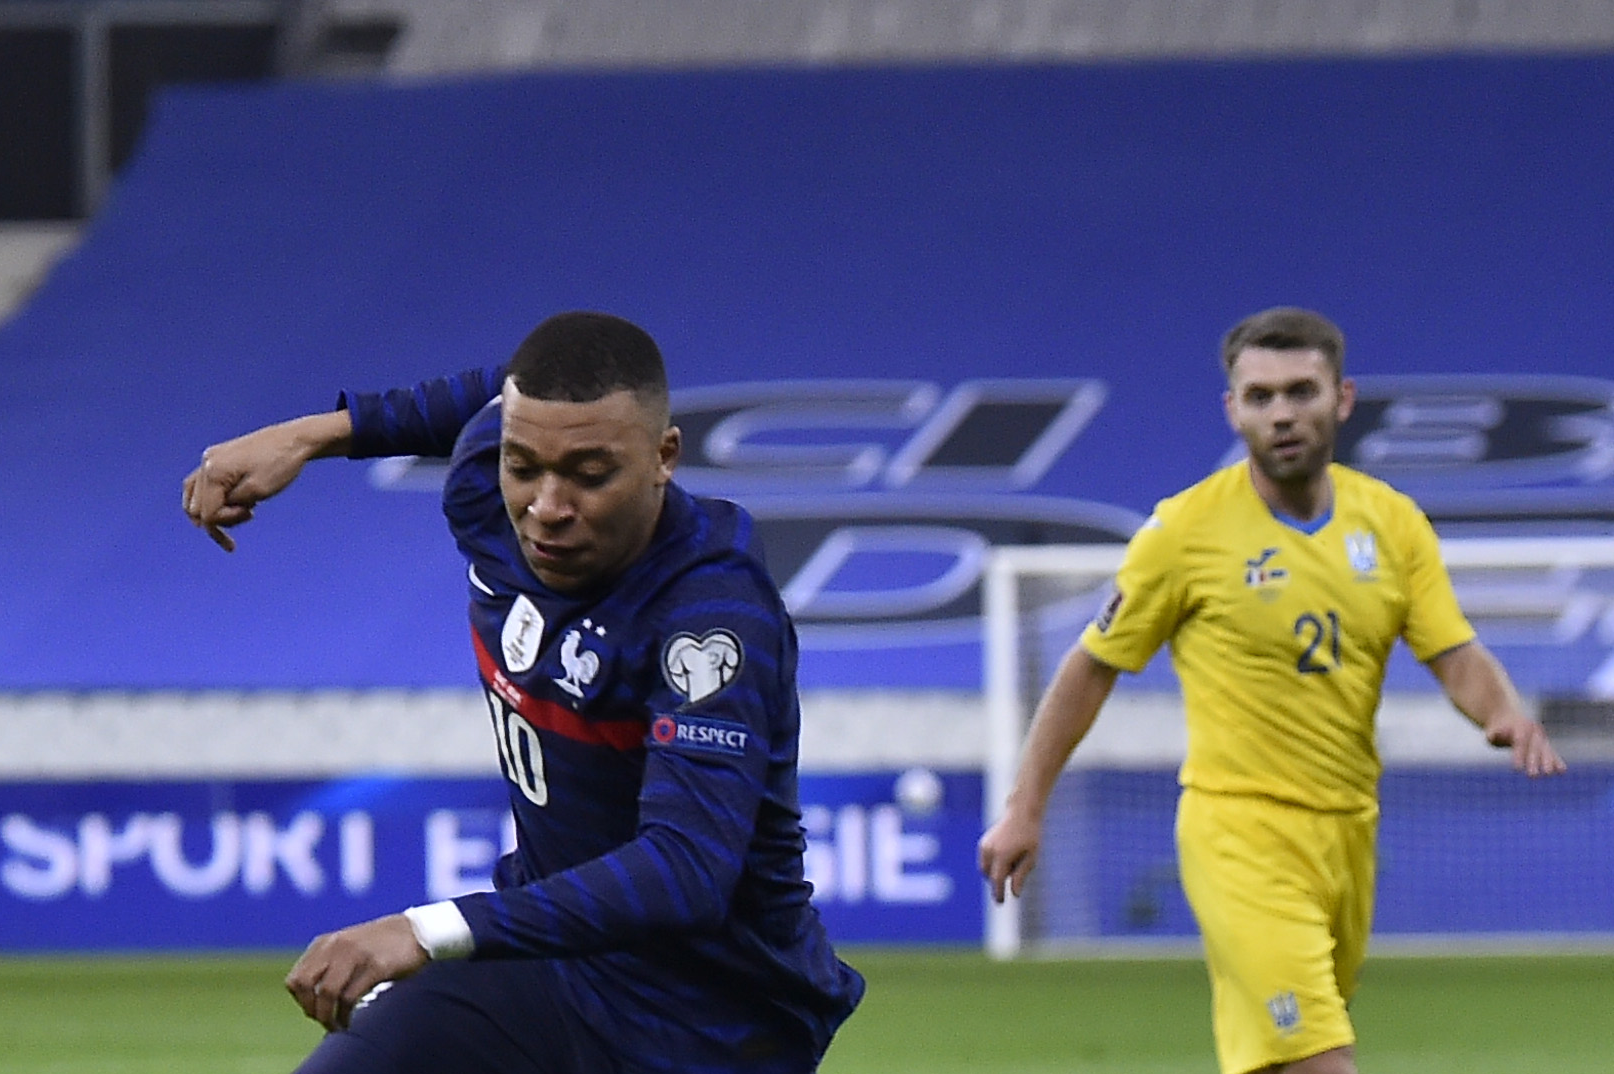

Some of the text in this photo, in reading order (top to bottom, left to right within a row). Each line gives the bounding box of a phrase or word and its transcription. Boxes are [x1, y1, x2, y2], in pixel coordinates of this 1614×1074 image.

[1294, 610, 1342, 675] 21
[489, 691, 548, 807] 10
[677, 723, 748, 749] RESPECT
